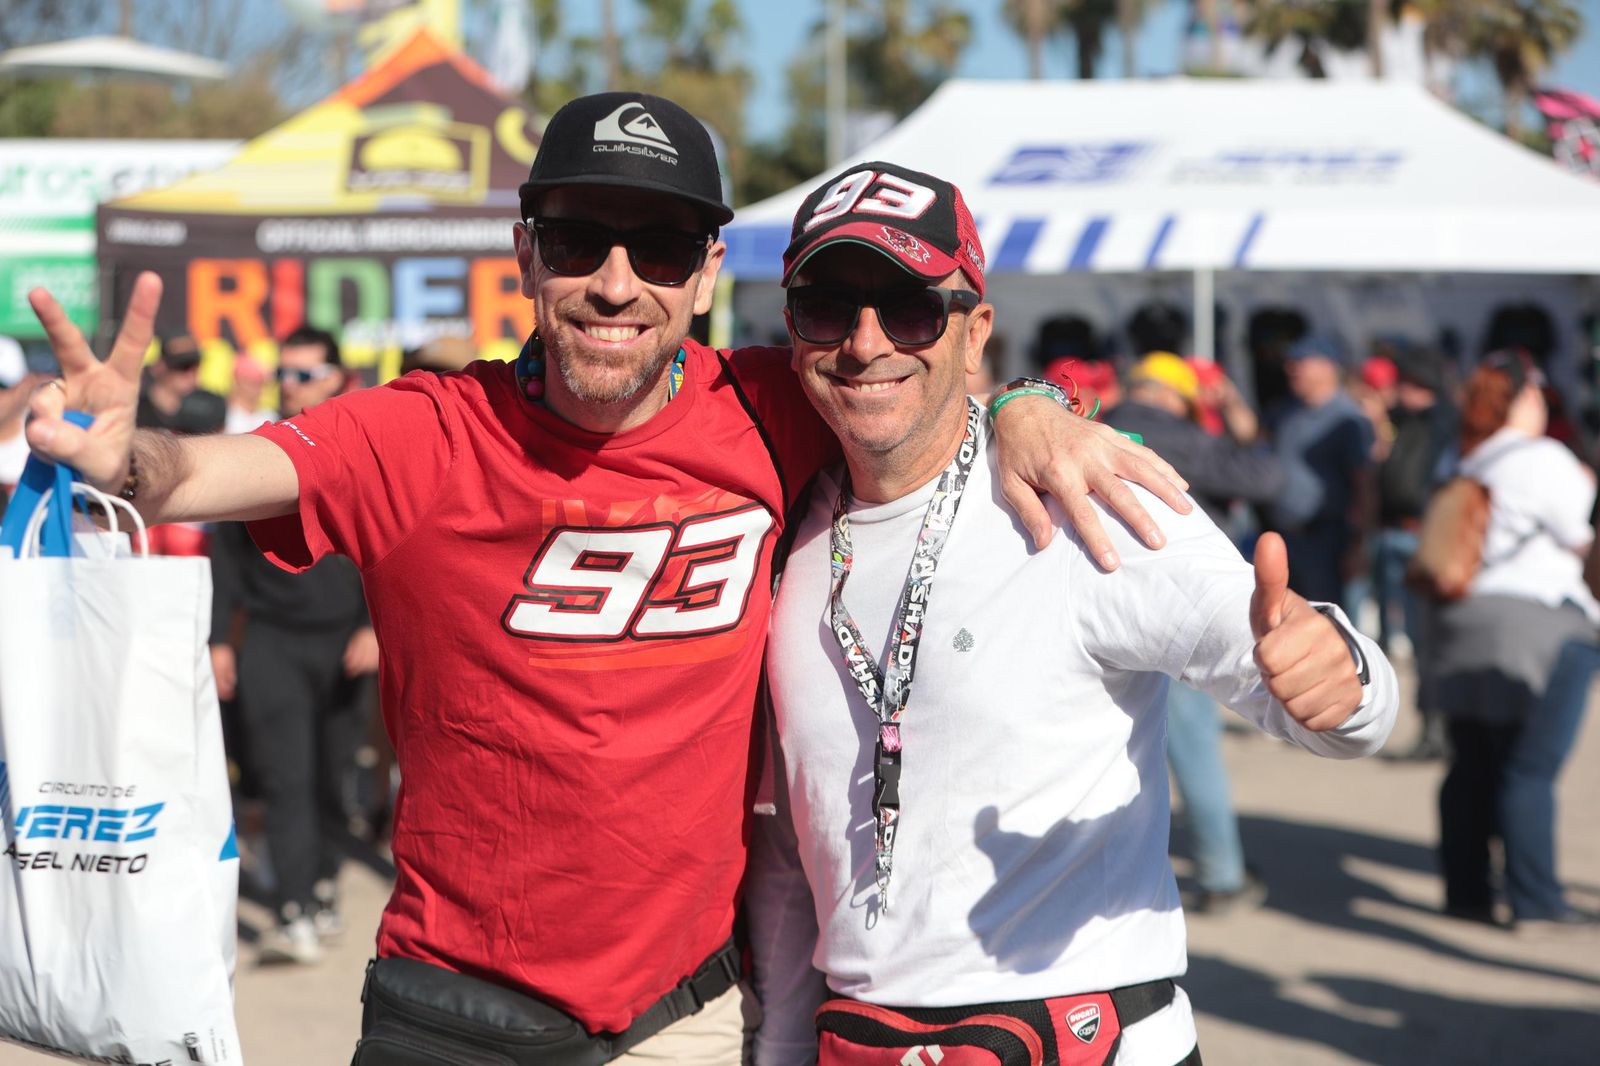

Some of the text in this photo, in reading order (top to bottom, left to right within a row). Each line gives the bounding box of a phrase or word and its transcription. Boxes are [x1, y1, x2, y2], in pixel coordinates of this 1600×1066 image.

[593, 143, 678, 166] QUIKSILVER
[803, 169, 938, 233] 93
[500, 500, 776, 643] 93
[898, 583, 926, 666] SHAD
[837, 626, 877, 698] SHAD
[38, 781, 138, 798] CIRCUITO DE
[70, 852, 148, 874] NIETO
[1070, 1007, 1096, 1023] DUCATI
